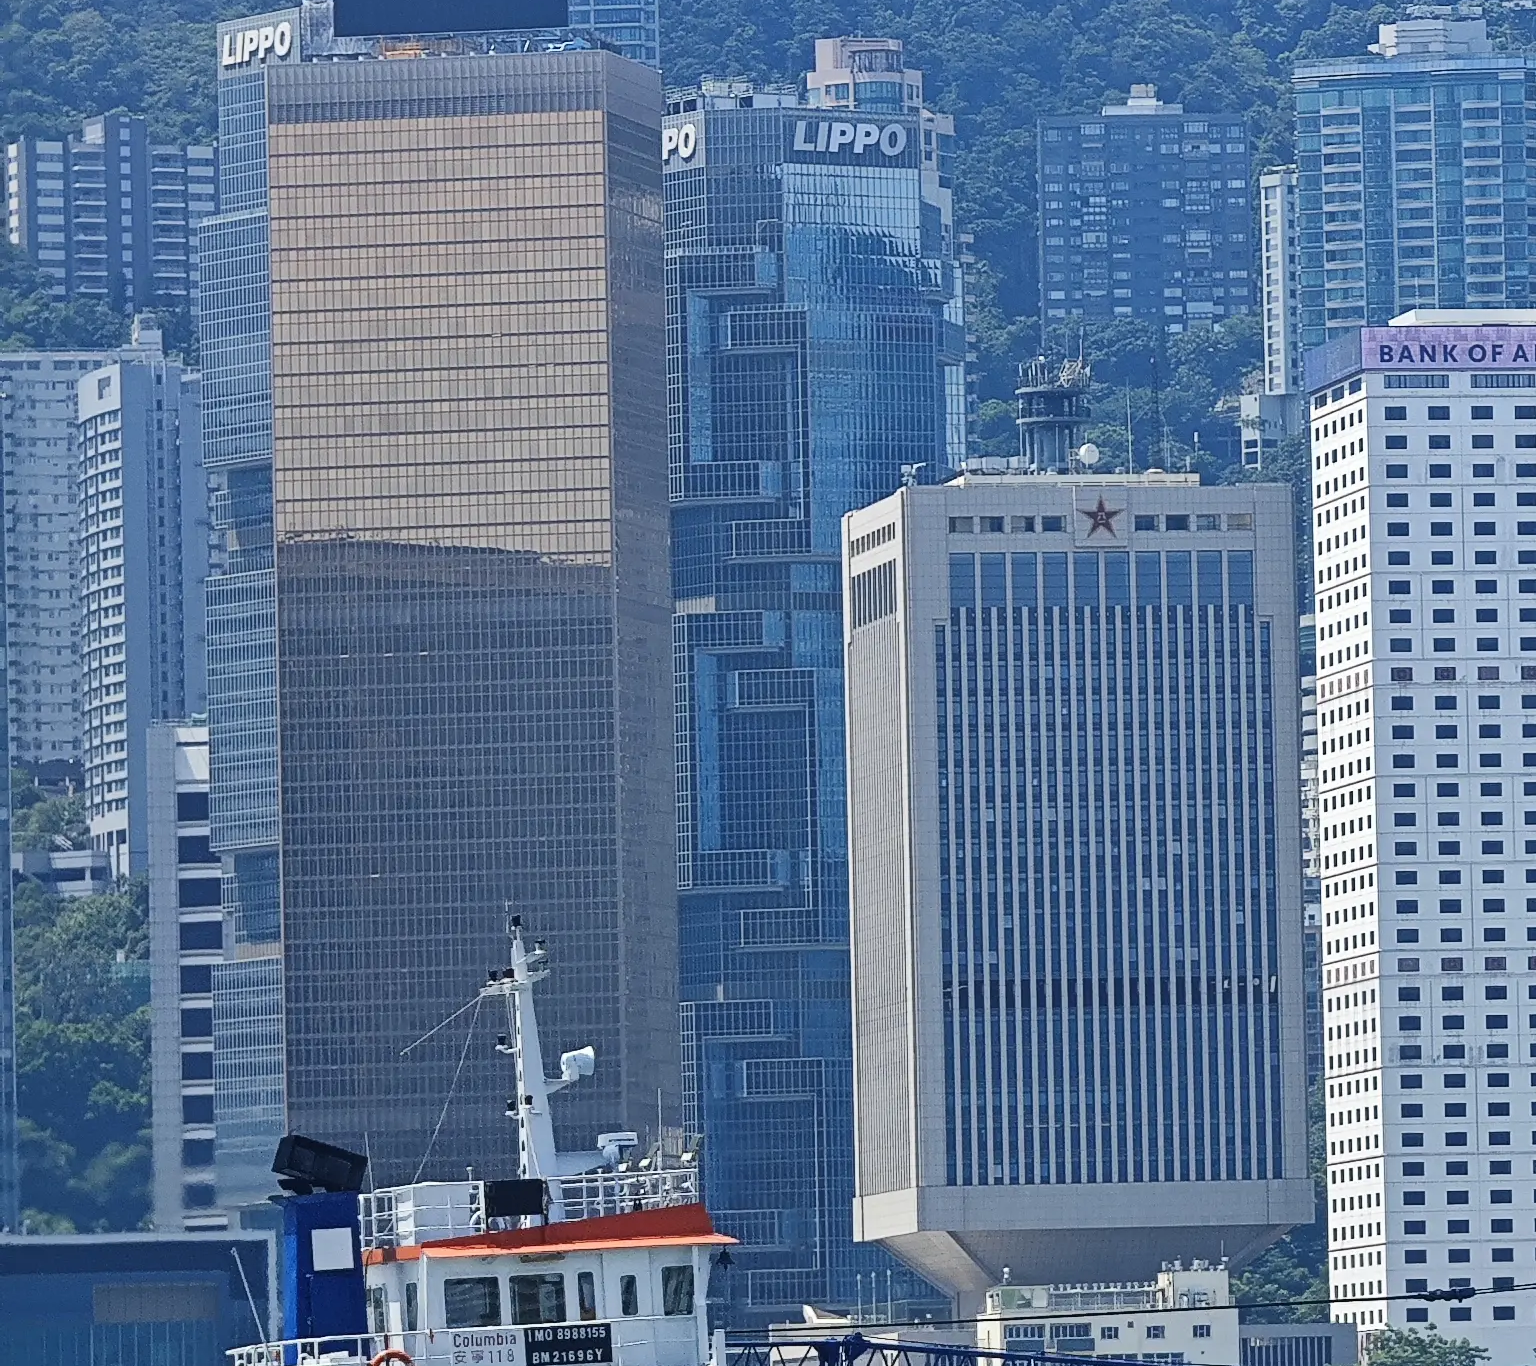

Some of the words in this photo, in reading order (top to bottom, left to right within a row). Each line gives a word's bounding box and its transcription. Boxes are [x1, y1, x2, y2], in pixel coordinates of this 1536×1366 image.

[222, 21, 291, 66] LIPPO
[793, 120, 907, 156] LIPPO
[1379, 344, 1459, 363] BANK
[1468, 344, 1503, 363] OF
[453, 1332, 517, 1348] Columbia
[528, 1329, 553, 1343] IMO
[557, 1327, 606, 1340] 8988155
